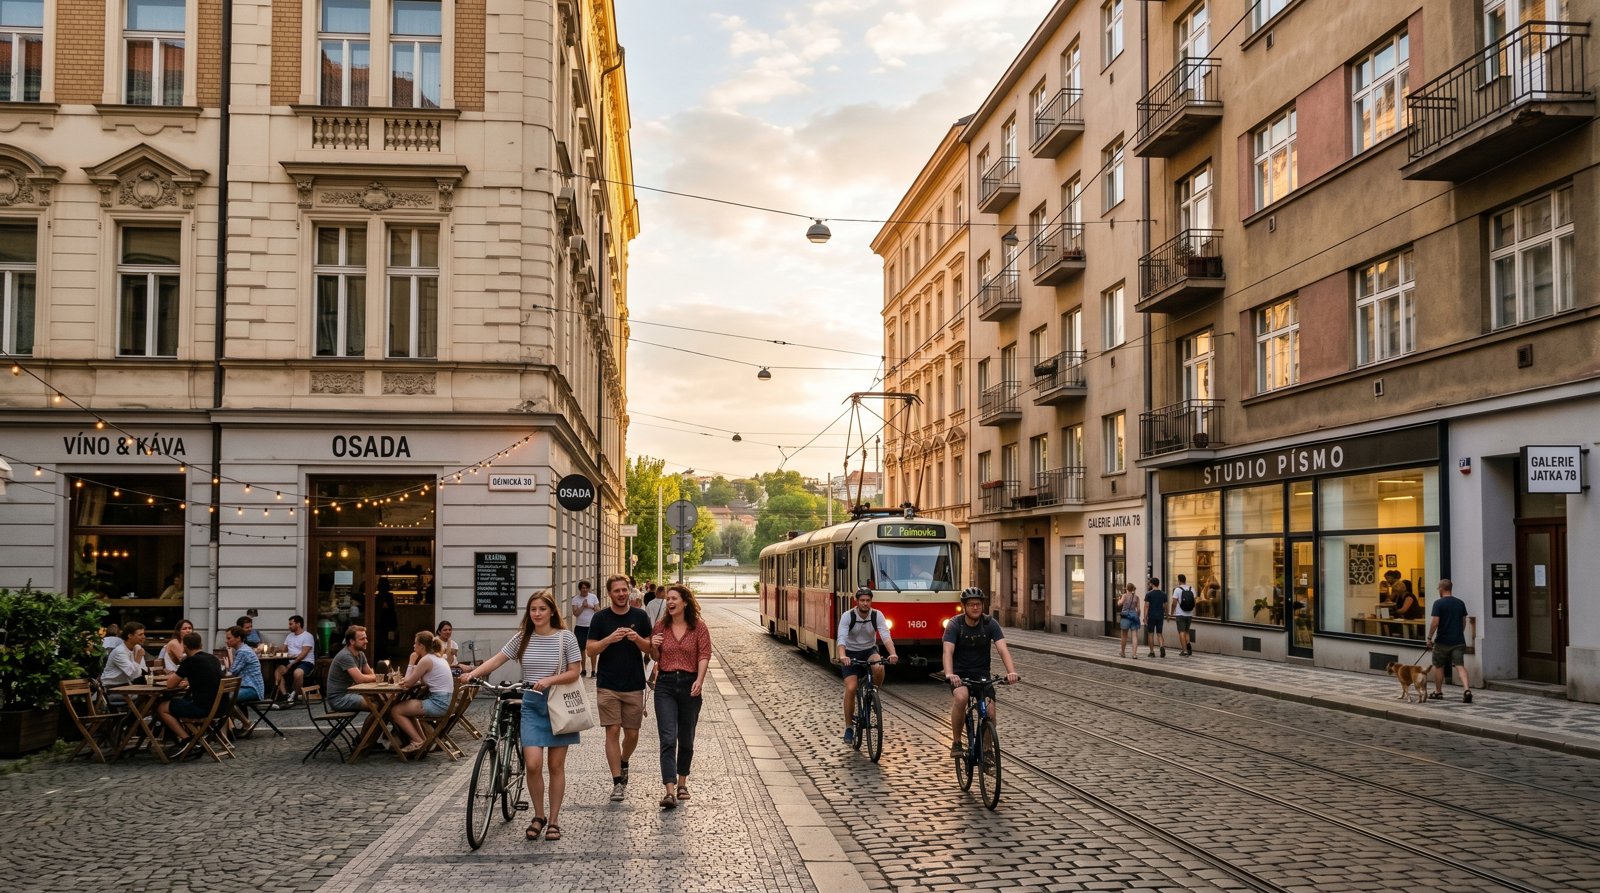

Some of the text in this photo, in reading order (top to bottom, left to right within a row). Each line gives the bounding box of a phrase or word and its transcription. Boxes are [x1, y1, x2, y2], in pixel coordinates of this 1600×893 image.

[63, 431, 186, 455] VÍNO & KÁVA
[332, 435, 411, 458] OSADA
[1203, 445, 1344, 485] STUDIO PÍSMO
[1531, 456, 1574, 467] GALERIE
[1531, 470, 1577, 481] JATKA 78
[523, 478, 532, 486] 30
[559, 488, 591, 498] OSADA
[1088, 514, 1141, 529] GALERIE JATKA 78
[884, 525, 893, 537] 12
[907, 620, 927, 629] 1480
